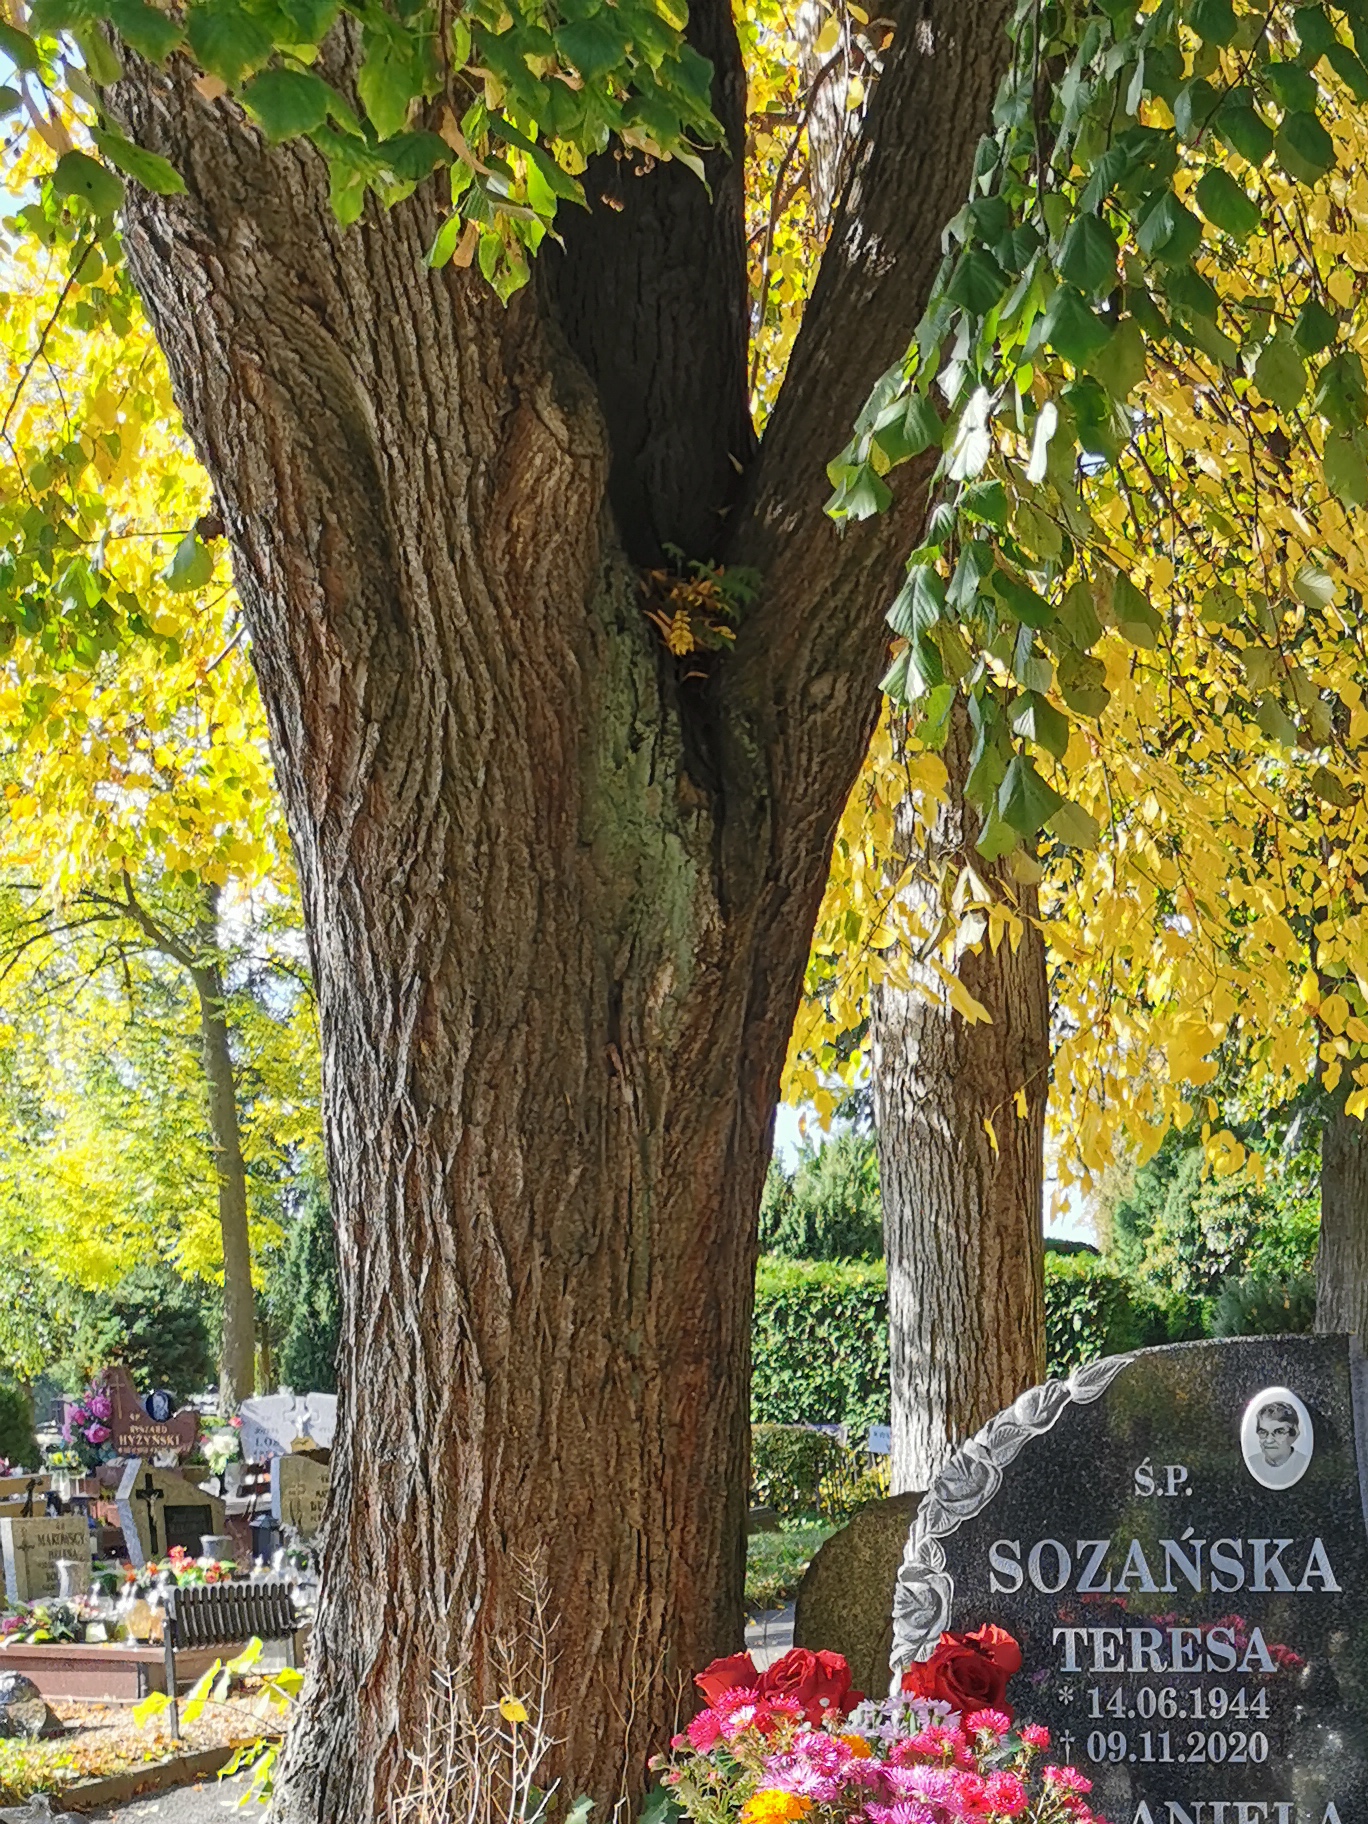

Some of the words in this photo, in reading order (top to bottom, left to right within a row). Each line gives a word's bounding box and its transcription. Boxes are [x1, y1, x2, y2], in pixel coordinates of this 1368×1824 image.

[1134, 1457, 1193, 1497] Ś.P.
[988, 1527, 1342, 1594] SOZAŃSKA
[1052, 1626, 1278, 1673] TERESA
[1086, 1686, 1271, 1720] 14.06.1944
[1086, 1731, 1270, 1764] 09.11.2020
